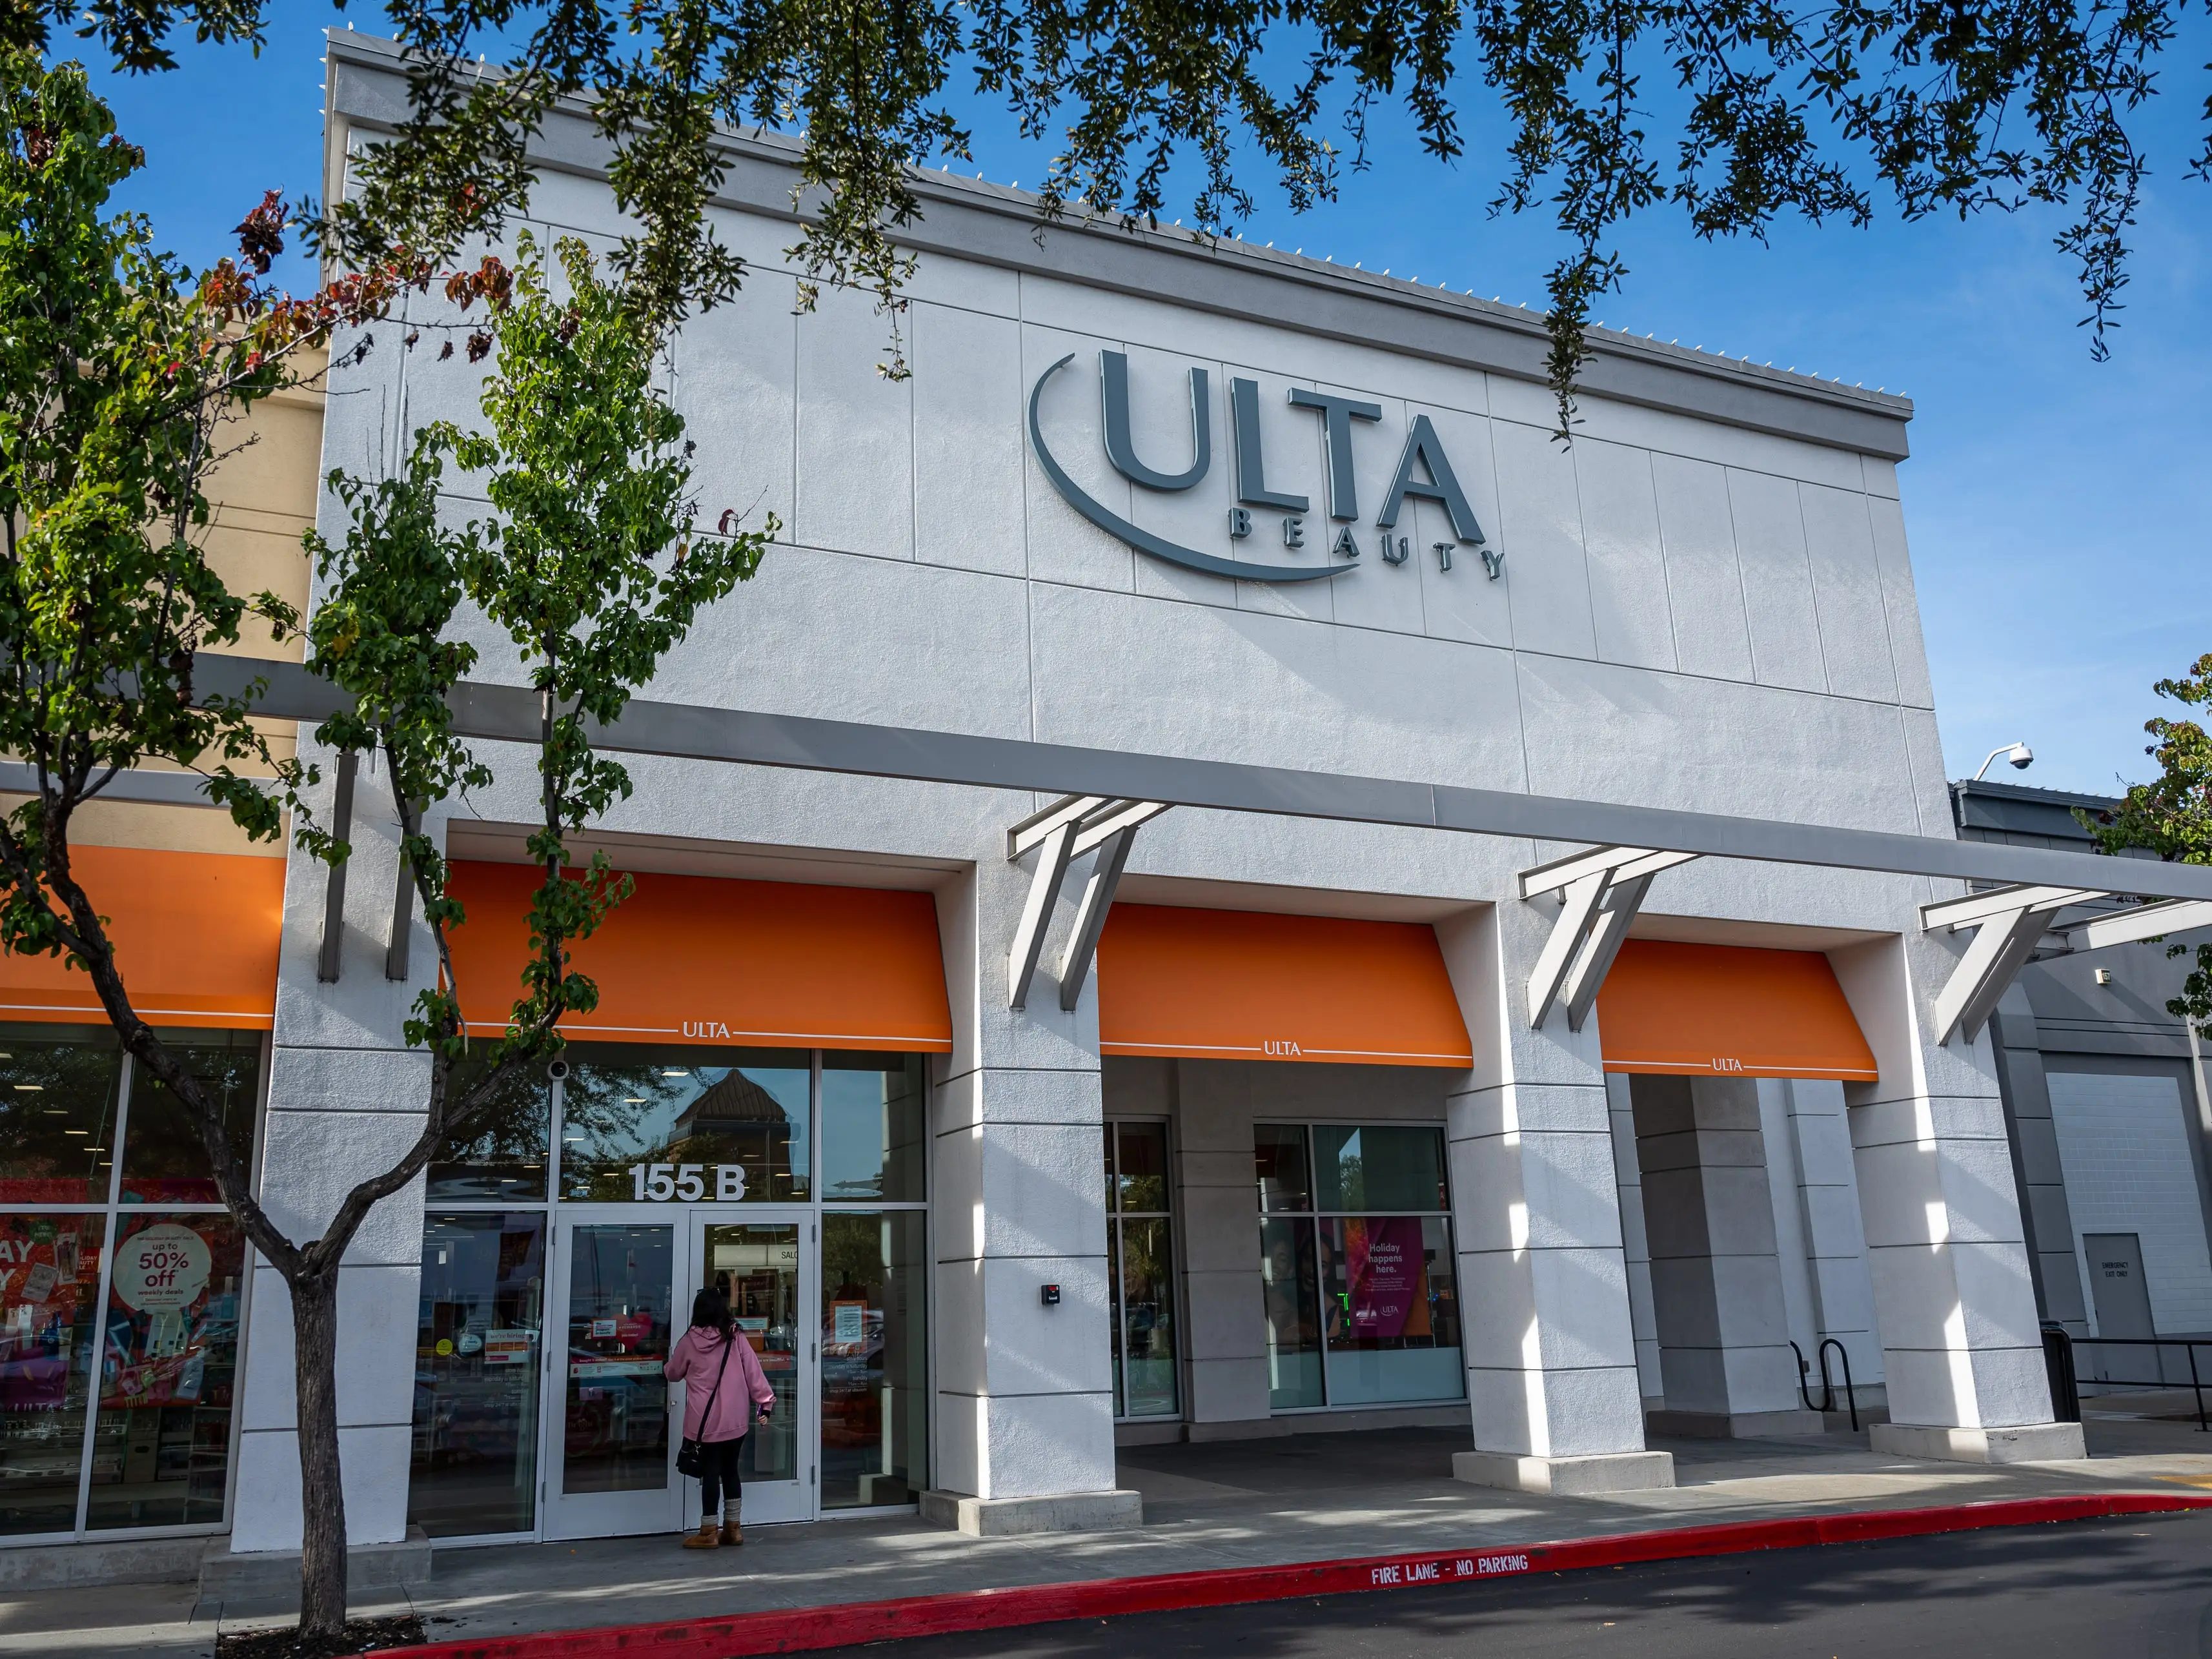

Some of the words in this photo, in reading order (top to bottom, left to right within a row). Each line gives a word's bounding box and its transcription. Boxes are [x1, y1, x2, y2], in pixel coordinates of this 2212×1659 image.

[1099, 349, 1486, 545] ULTA
[1228, 507, 1504, 580] BEAUTY
[683, 1021, 730, 1039] ULTA
[1264, 1041, 1301, 1056] ULTA
[1712, 1058, 1743, 1071] ULTA
[629, 1163, 704, 1201] 155
[716, 1164, 745, 1201] B
[1369, 1243, 1400, 1254] Holiday
[139, 1252, 189, 1270] 50%
[1369, 1254, 1403, 1264] happens
[1376, 1265, 1397, 1273] here.
[1371, 1565, 1402, 1584] FIRE
[1405, 1562, 1440, 1581] LANE
[1455, 1560, 1474, 1576] NO
[1477, 1555, 1528, 1574] PARKING
